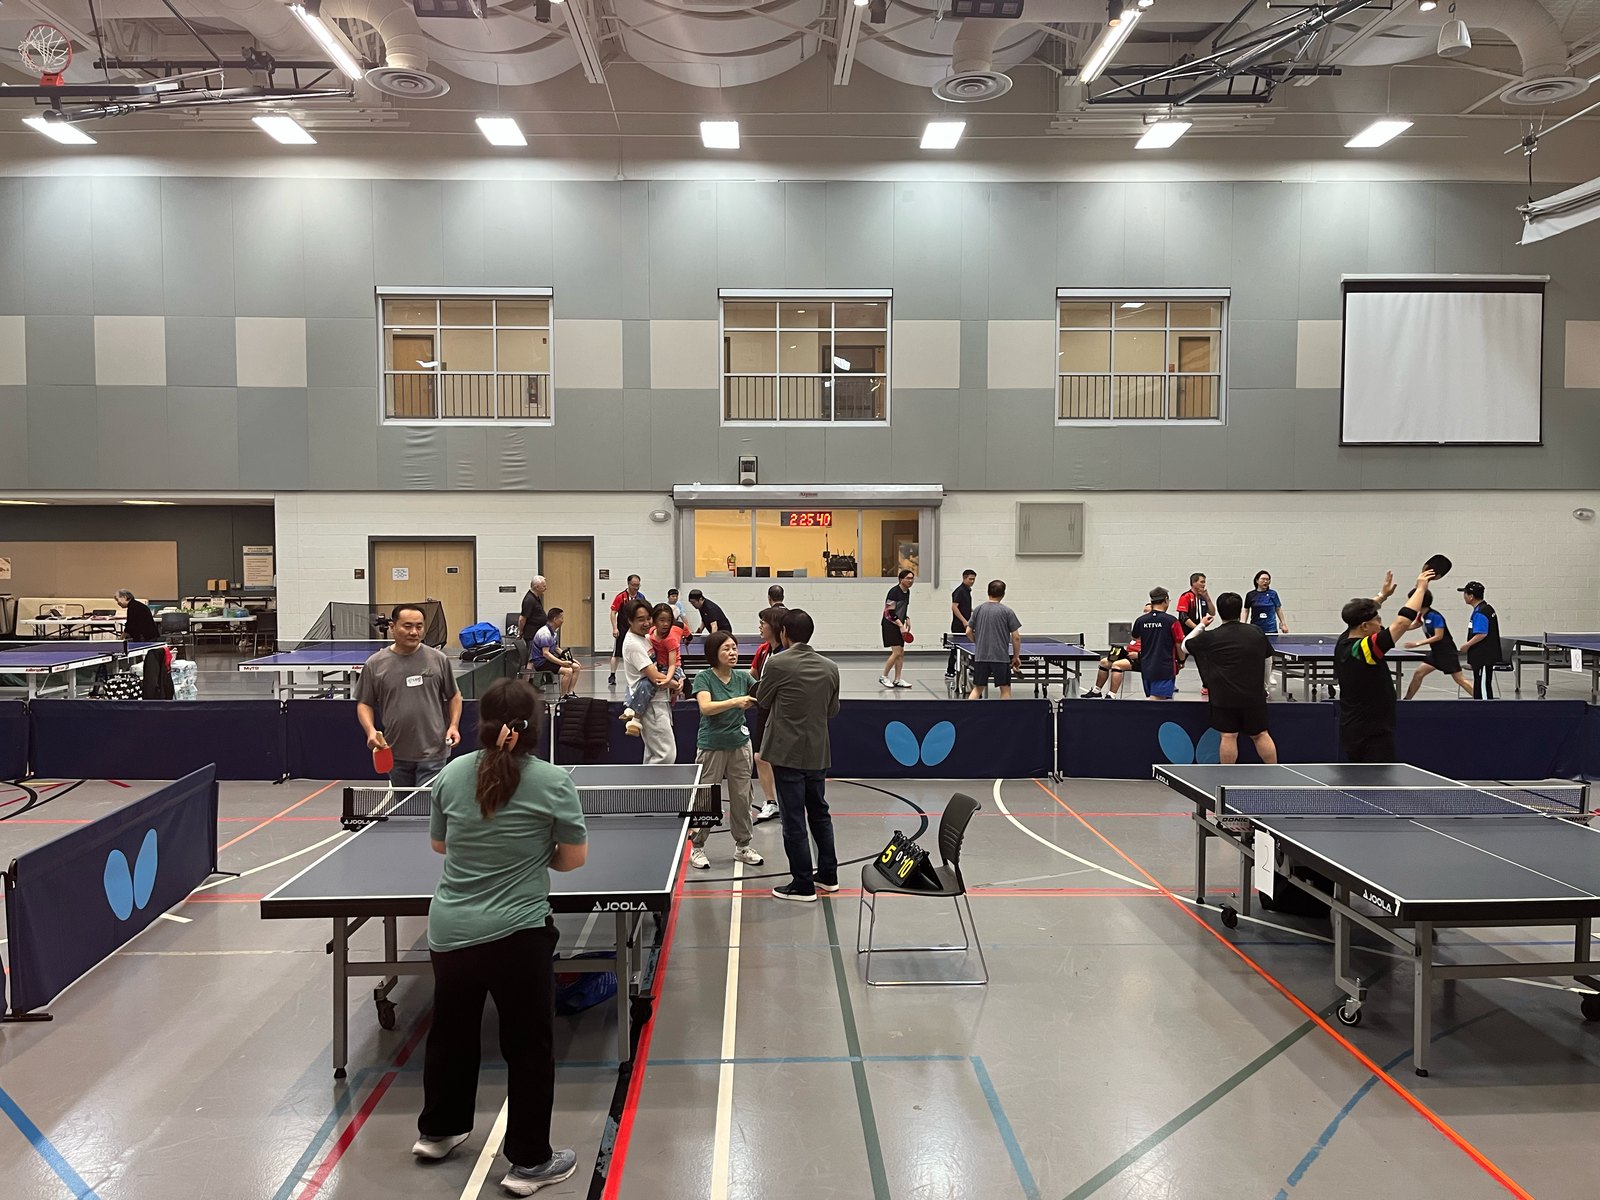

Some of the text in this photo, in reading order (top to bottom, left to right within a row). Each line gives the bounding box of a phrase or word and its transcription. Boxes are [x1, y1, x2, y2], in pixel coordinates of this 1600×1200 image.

[882, 845, 897, 863] 5
[897, 857, 914, 878] 10
[1261, 844, 1271, 873] 2
[603, 901, 648, 911] JOOLA
[1368, 893, 1392, 913] JOOLA
